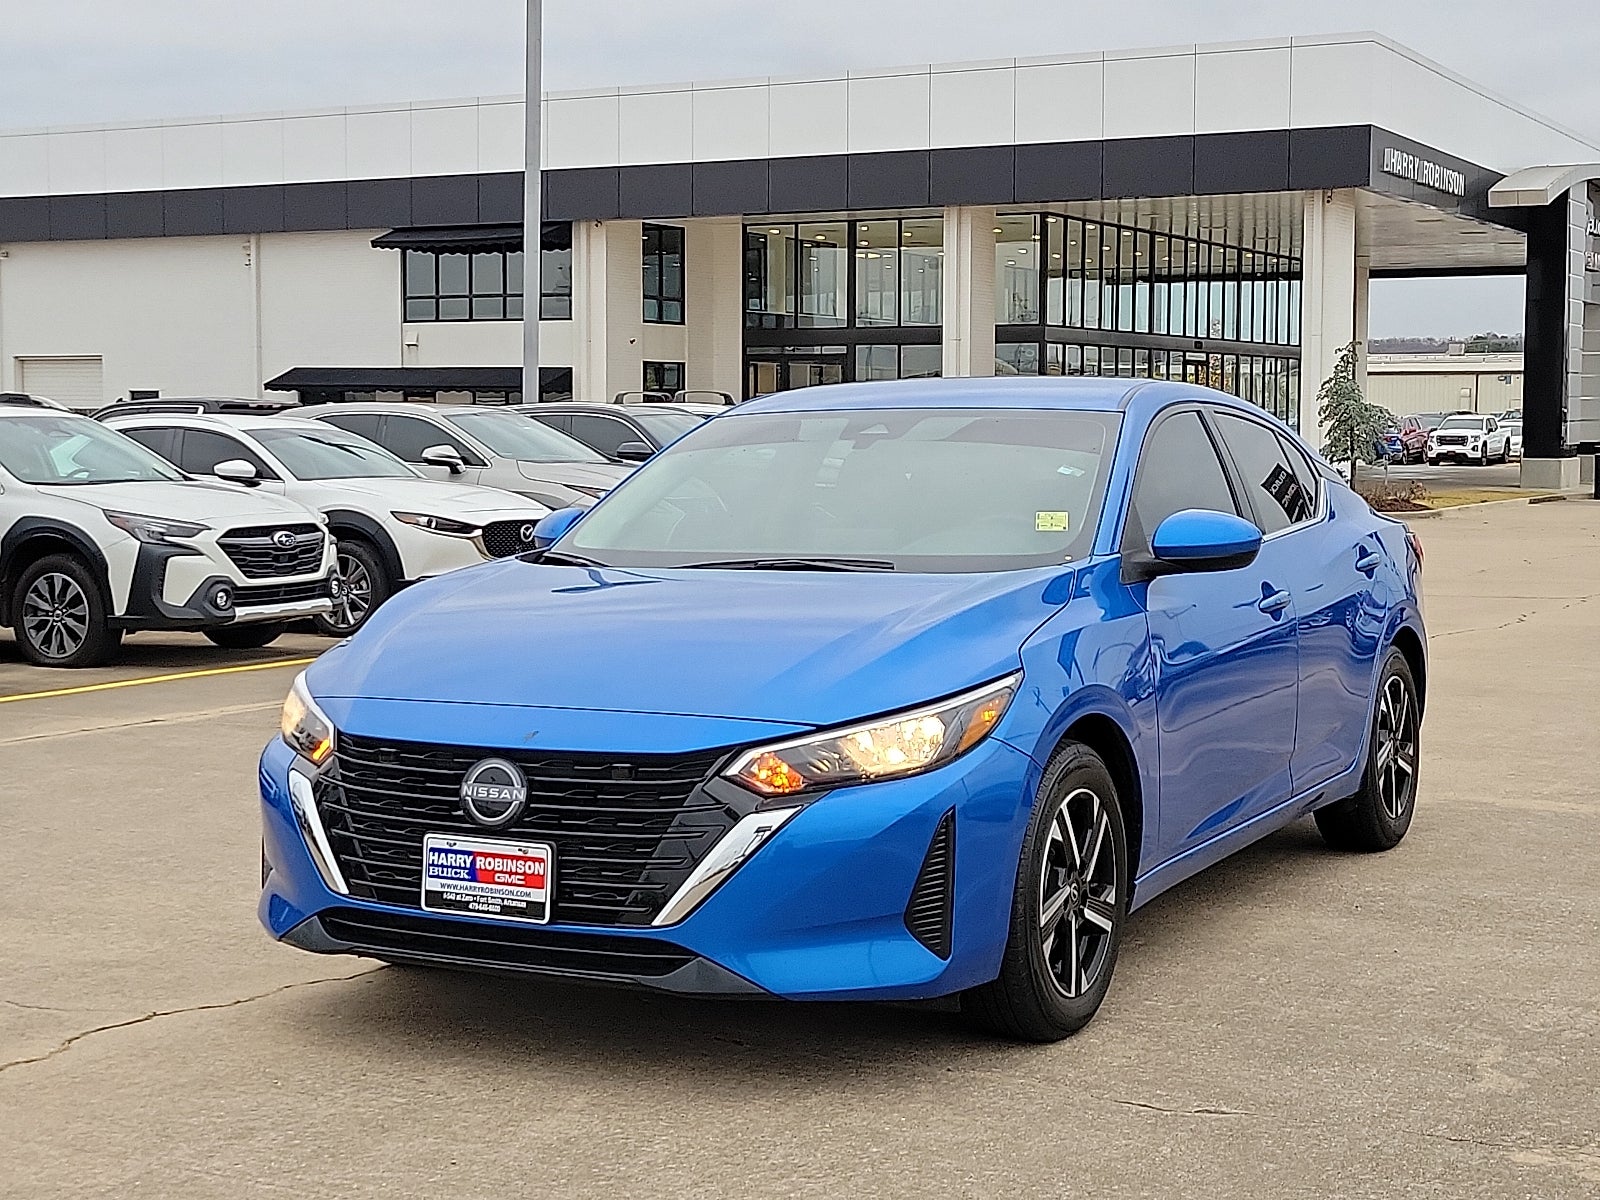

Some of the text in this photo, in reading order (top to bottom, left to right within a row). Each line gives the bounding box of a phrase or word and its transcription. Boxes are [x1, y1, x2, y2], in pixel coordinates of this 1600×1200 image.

[1384, 148, 1465, 197] HARRY ROBINSON
[463, 785, 525, 800] NISSAN
[428, 851, 545, 876] HARRY ROBINSON
[428, 866, 526, 885] BUICK GMC
[440, 882, 532, 898] WWW.HARRYROBINSON.COM
